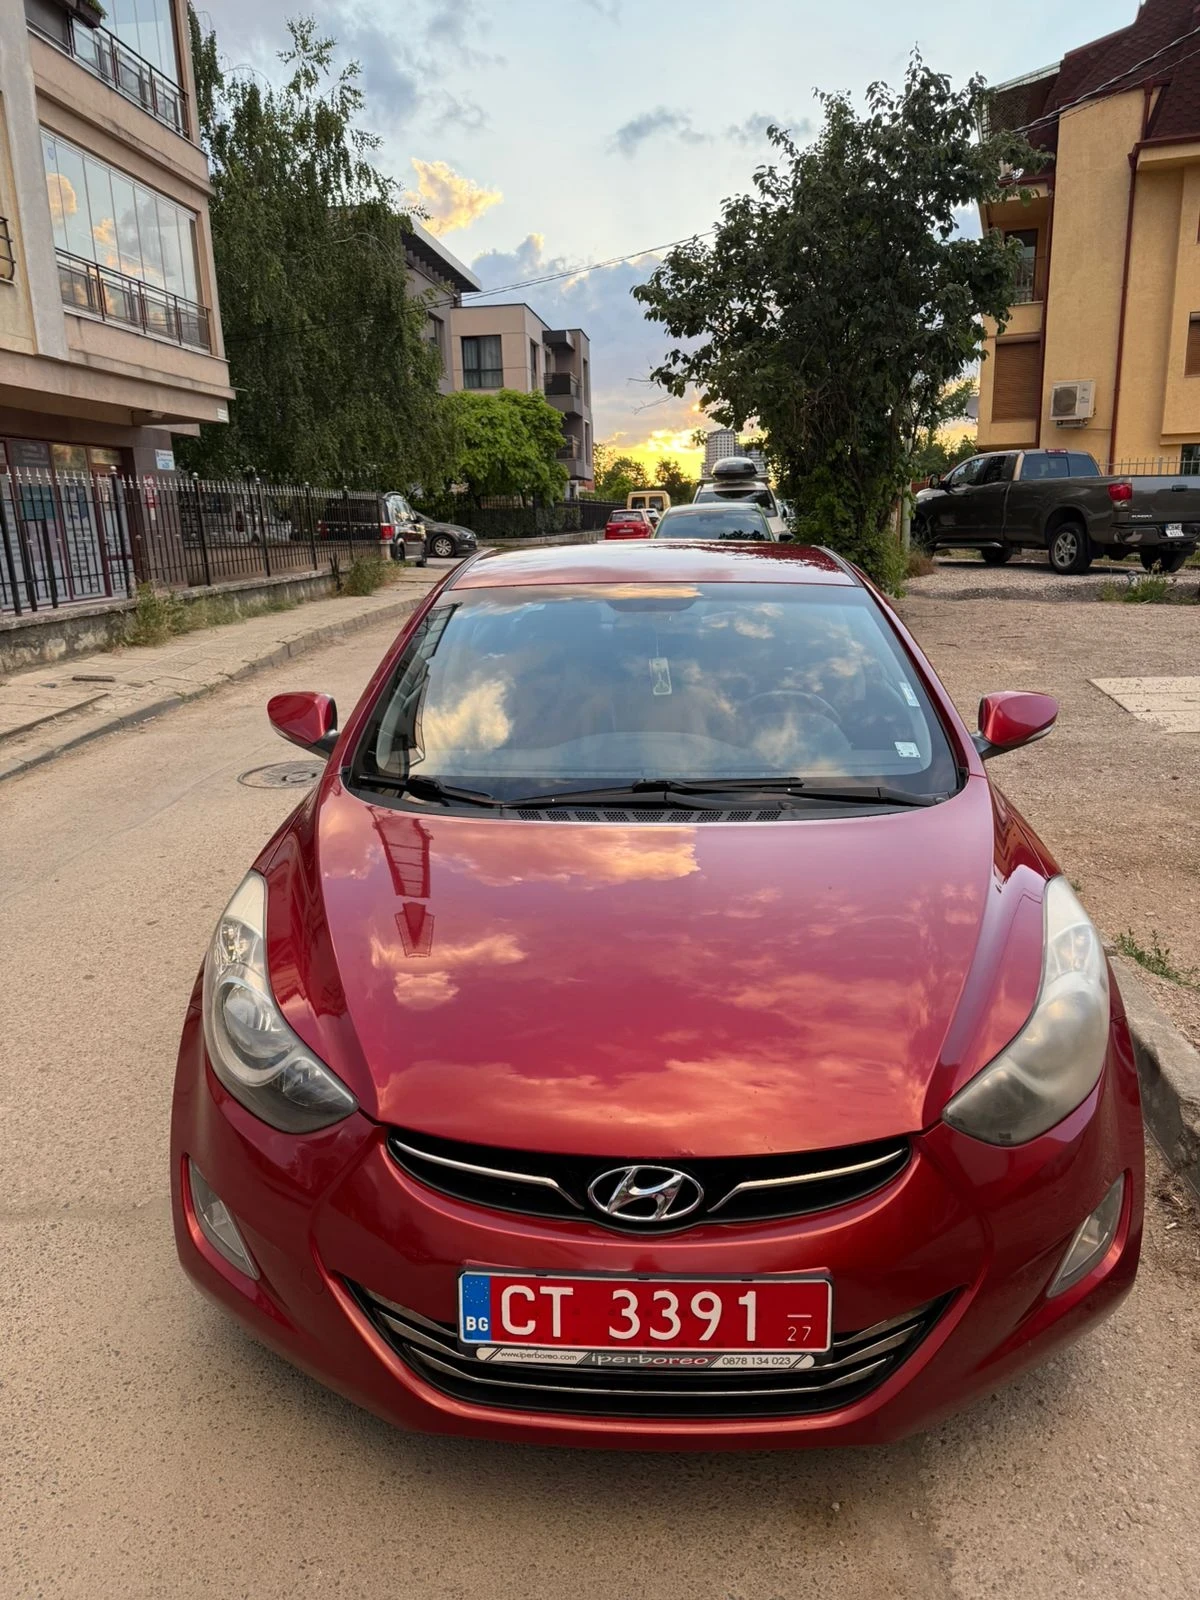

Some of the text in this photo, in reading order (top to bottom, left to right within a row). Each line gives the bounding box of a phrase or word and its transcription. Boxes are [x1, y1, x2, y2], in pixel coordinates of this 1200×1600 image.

[501, 1284, 757, 1342] CT 3391
[465, 1316, 489, 1332] BG
[787, 1326, 812, 1342] 27
[500, 1351, 577, 1362] www.iperboreo.com
[591, 1353, 709, 1366] iperboreo
[722, 1356, 791, 1366] 0878 134 023
